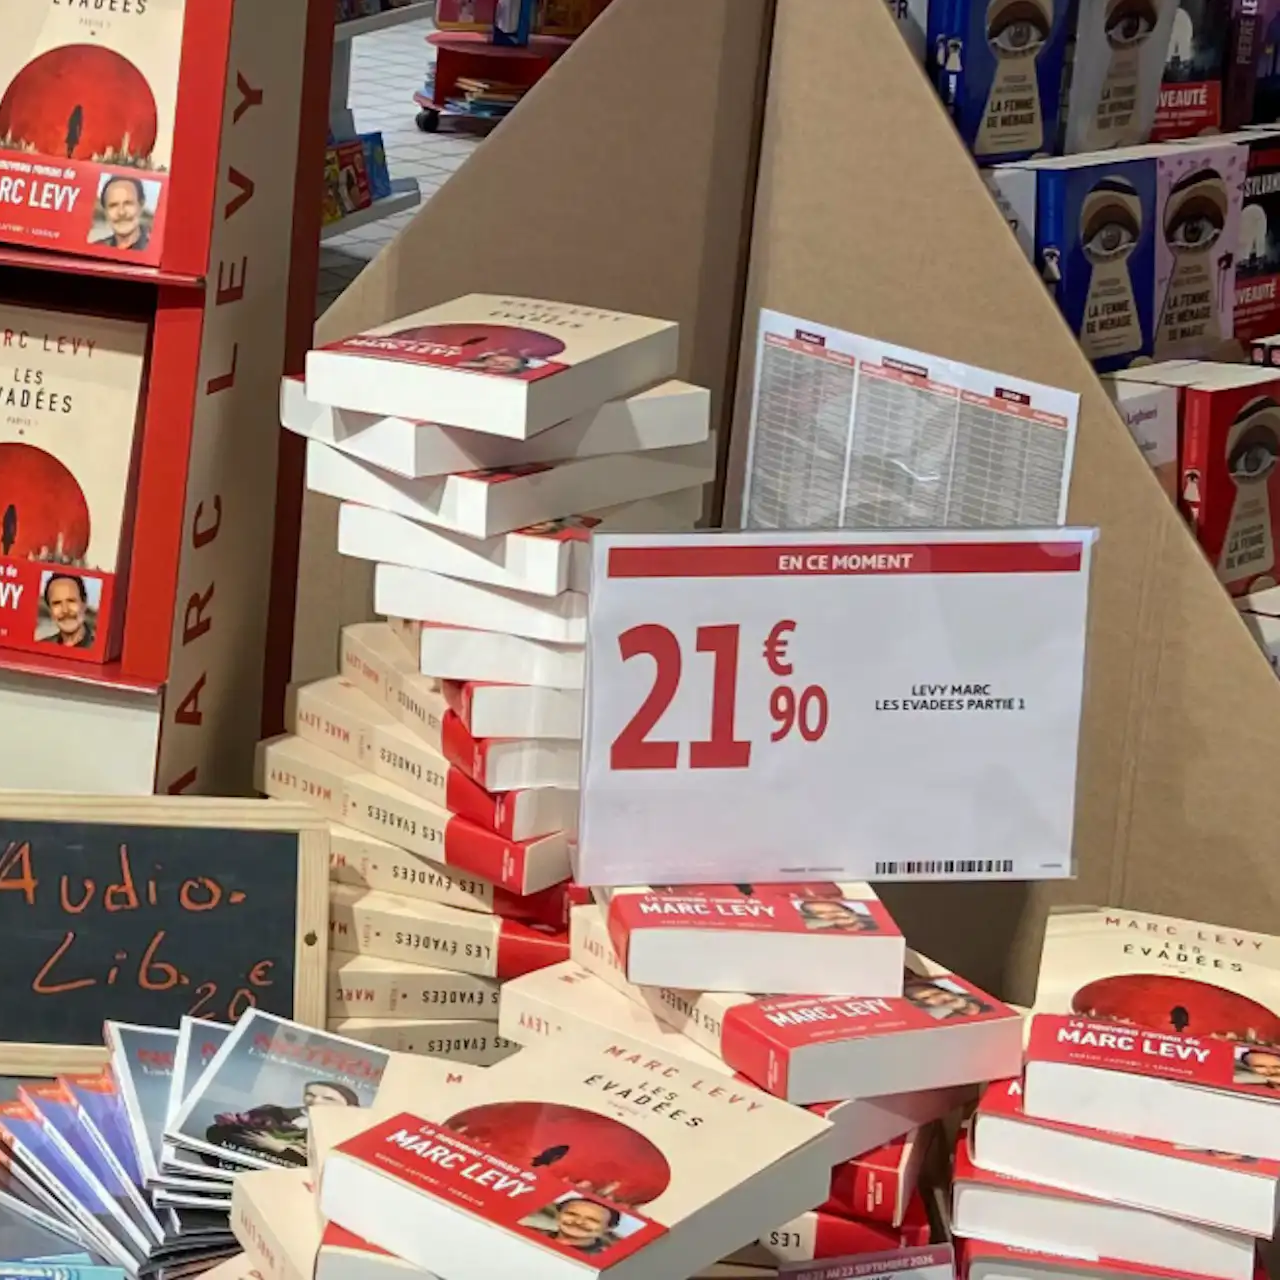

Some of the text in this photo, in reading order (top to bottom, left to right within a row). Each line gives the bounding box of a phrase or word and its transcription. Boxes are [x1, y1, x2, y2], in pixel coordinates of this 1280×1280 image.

[29, 181, 81, 212] LEVY
[206, 70, 266, 397] LEVY
[42, 334, 97, 359] LEVY
[14, 367, 43, 385] LES
[777, 551, 913, 571] EN CE MOMENT
[610, 620, 797, 770] 21 €
[911, 683, 991, 697] LEVY MARC
[768, 684, 829, 743] 90
[875, 698, 1026, 712] LES EVADEES PARTIE 1
[322, 721, 350, 743] MARC
[270, 768, 332, 801] MARC LEVY
[366, 804, 444, 844] LES ÉVADÉES
[391, 863, 485, 896] LES ÉVADÉES
[639, 901, 776, 918] MARC LEVY
[394, 931, 491, 959] LES ÉVADÉES
[1105, 914, 1264, 952] MARC LEVY
[336, 987, 486, 1008] ÉVADÉES MARC
[766, 998, 894, 1028] MARC LEVY
[427, 1037, 488, 1055] ÉVADÉES
[1057, 1026, 1212, 1065] MARC LEVY
[603, 1044, 765, 1113] MARC LEVY
[637, 1080, 680, 1102] LES
[385, 1129, 467, 1169] MARC
[459, 1162, 537, 1199] LEVY
[770, 1231, 801, 1248] LES
